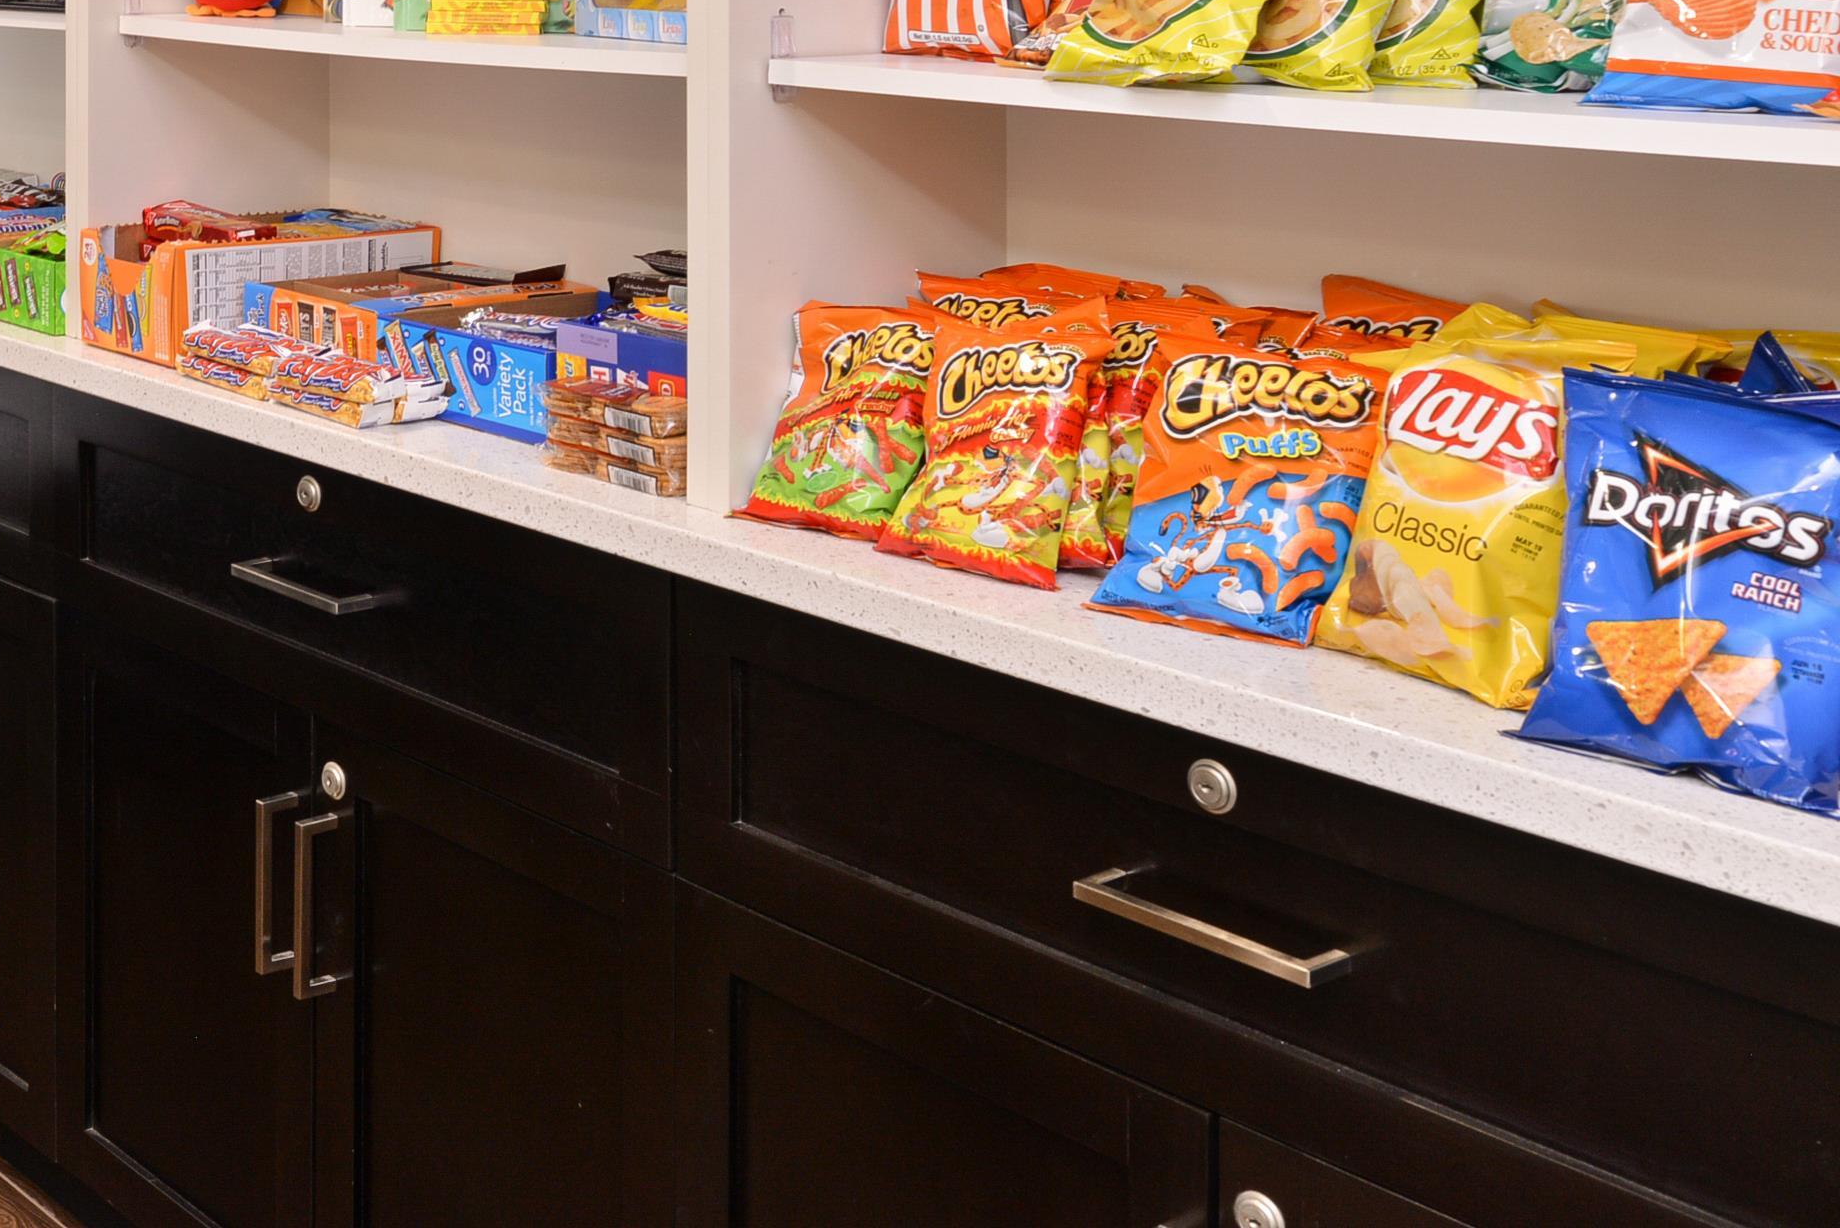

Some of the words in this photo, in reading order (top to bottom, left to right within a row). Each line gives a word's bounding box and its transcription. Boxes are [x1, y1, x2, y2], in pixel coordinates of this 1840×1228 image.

[1760, 33, 1776, 50] &
[1779, 34, 1832, 53] SOUR
[473, 347, 490, 378] 30
[825, 324, 935, 392] Cheetos
[937, 343, 1075, 417] Cheetos
[498, 352, 515, 418] Variety
[512, 368, 526, 414] Pack
[1165, 356, 1374, 434] Cheetos
[1387, 373, 1556, 460] Lay's
[1221, 430, 1322, 457] Puffs
[1372, 502, 1488, 561] Classic
[1515, 535, 1532, 547] MAY
[1587, 472, 1829, 566] Doritos
[1732, 583, 1801, 612] RANCH
[1750, 572, 1801, 597] COOL
